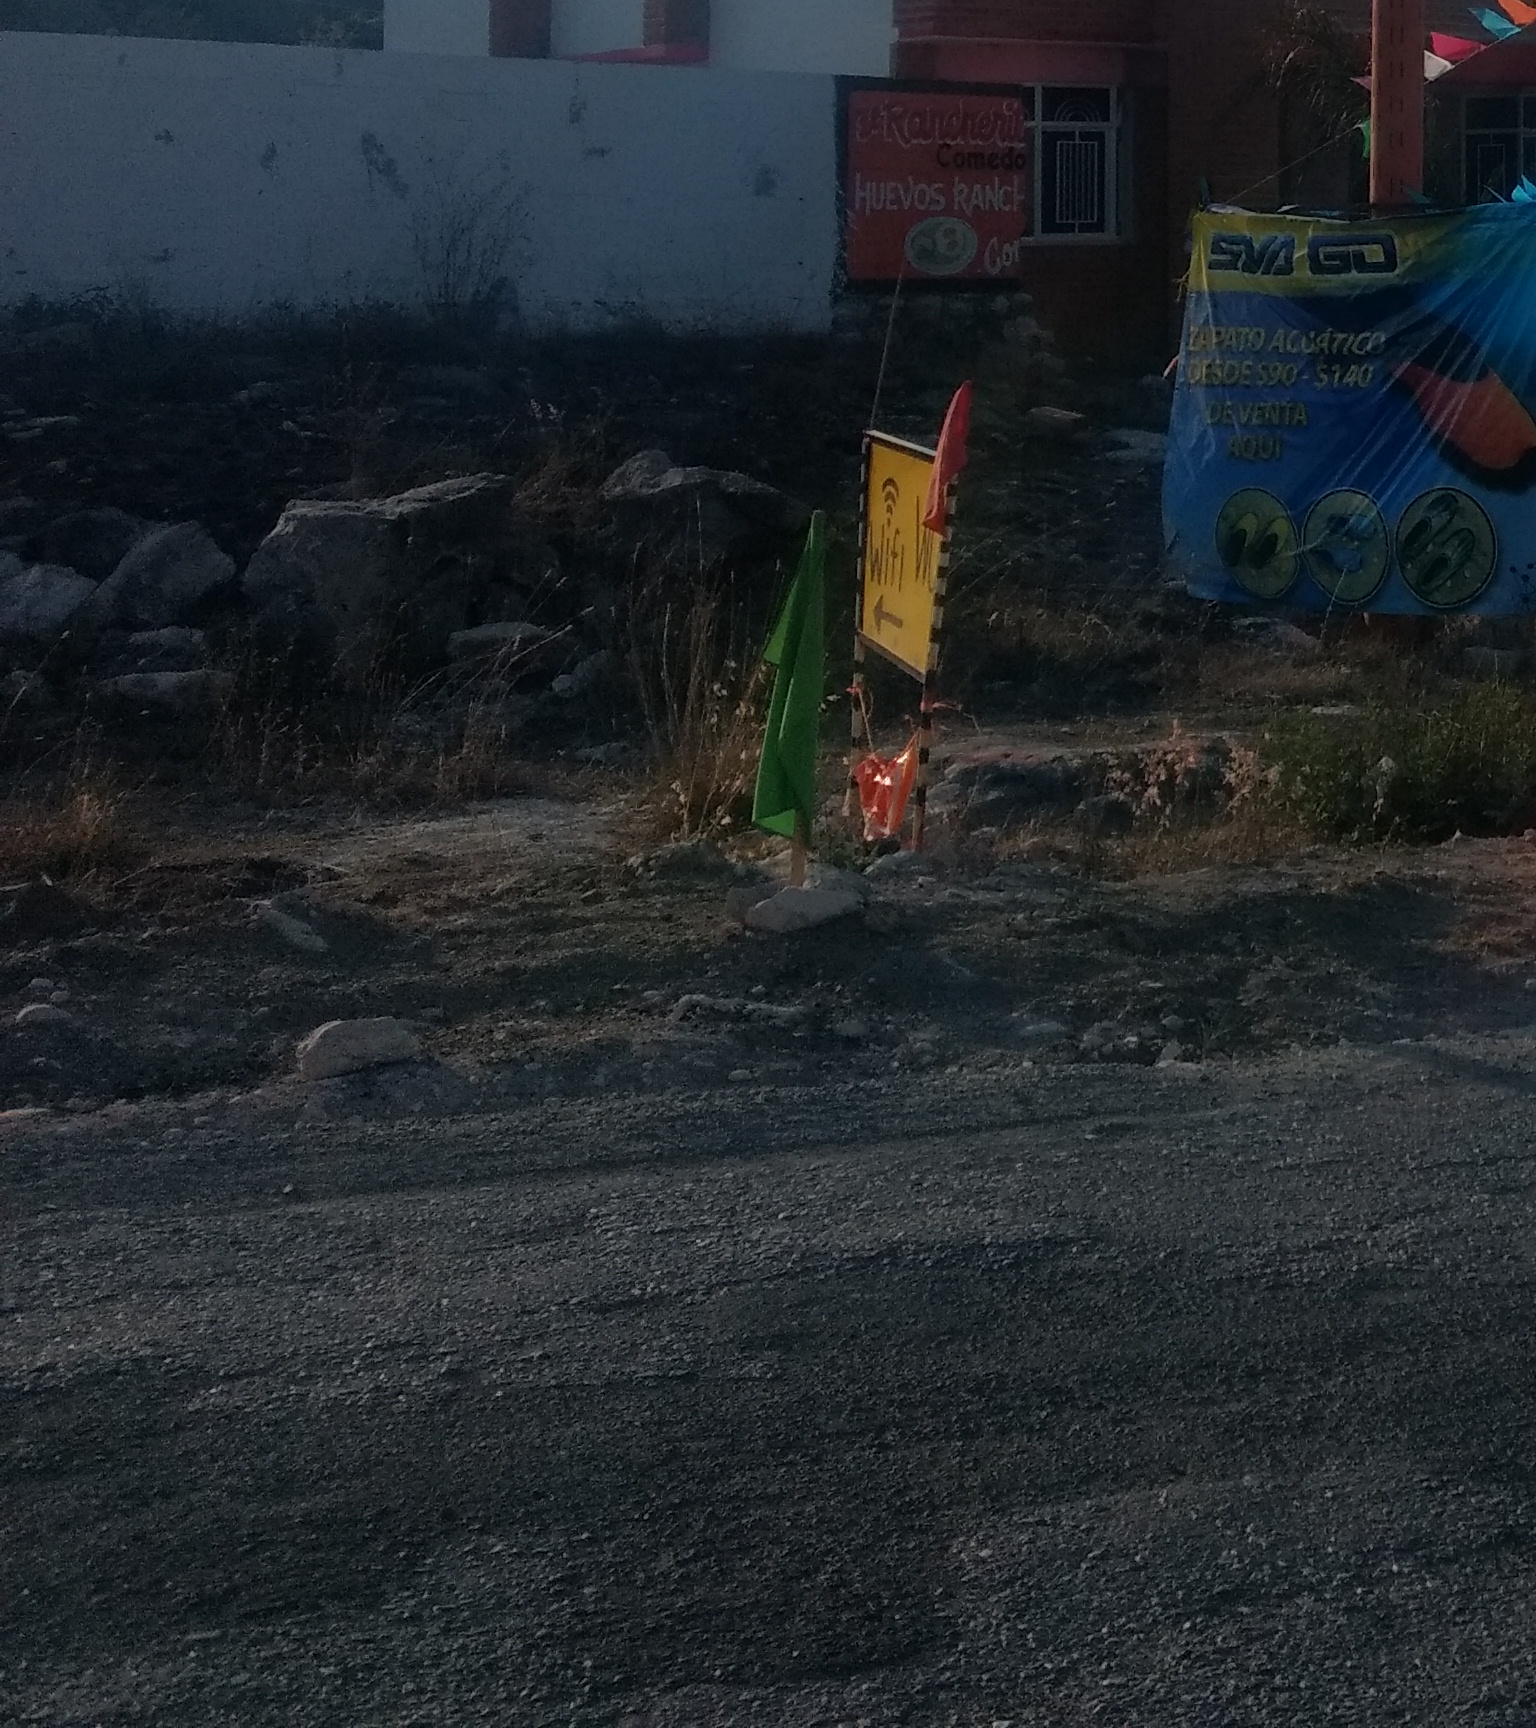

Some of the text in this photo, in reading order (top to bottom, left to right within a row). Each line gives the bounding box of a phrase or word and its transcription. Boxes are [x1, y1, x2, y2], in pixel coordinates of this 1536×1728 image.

[854, 170, 947, 216] HUEVOS
[1187, 325, 1388, 355] ZAPATO ACUÁTICO
[1187, 358, 1255, 387] DESDE
[1256, 361, 1299, 387] $90
[1313, 361, 1375, 391] $140
[1207, 400, 1309, 426] DE VENTA
